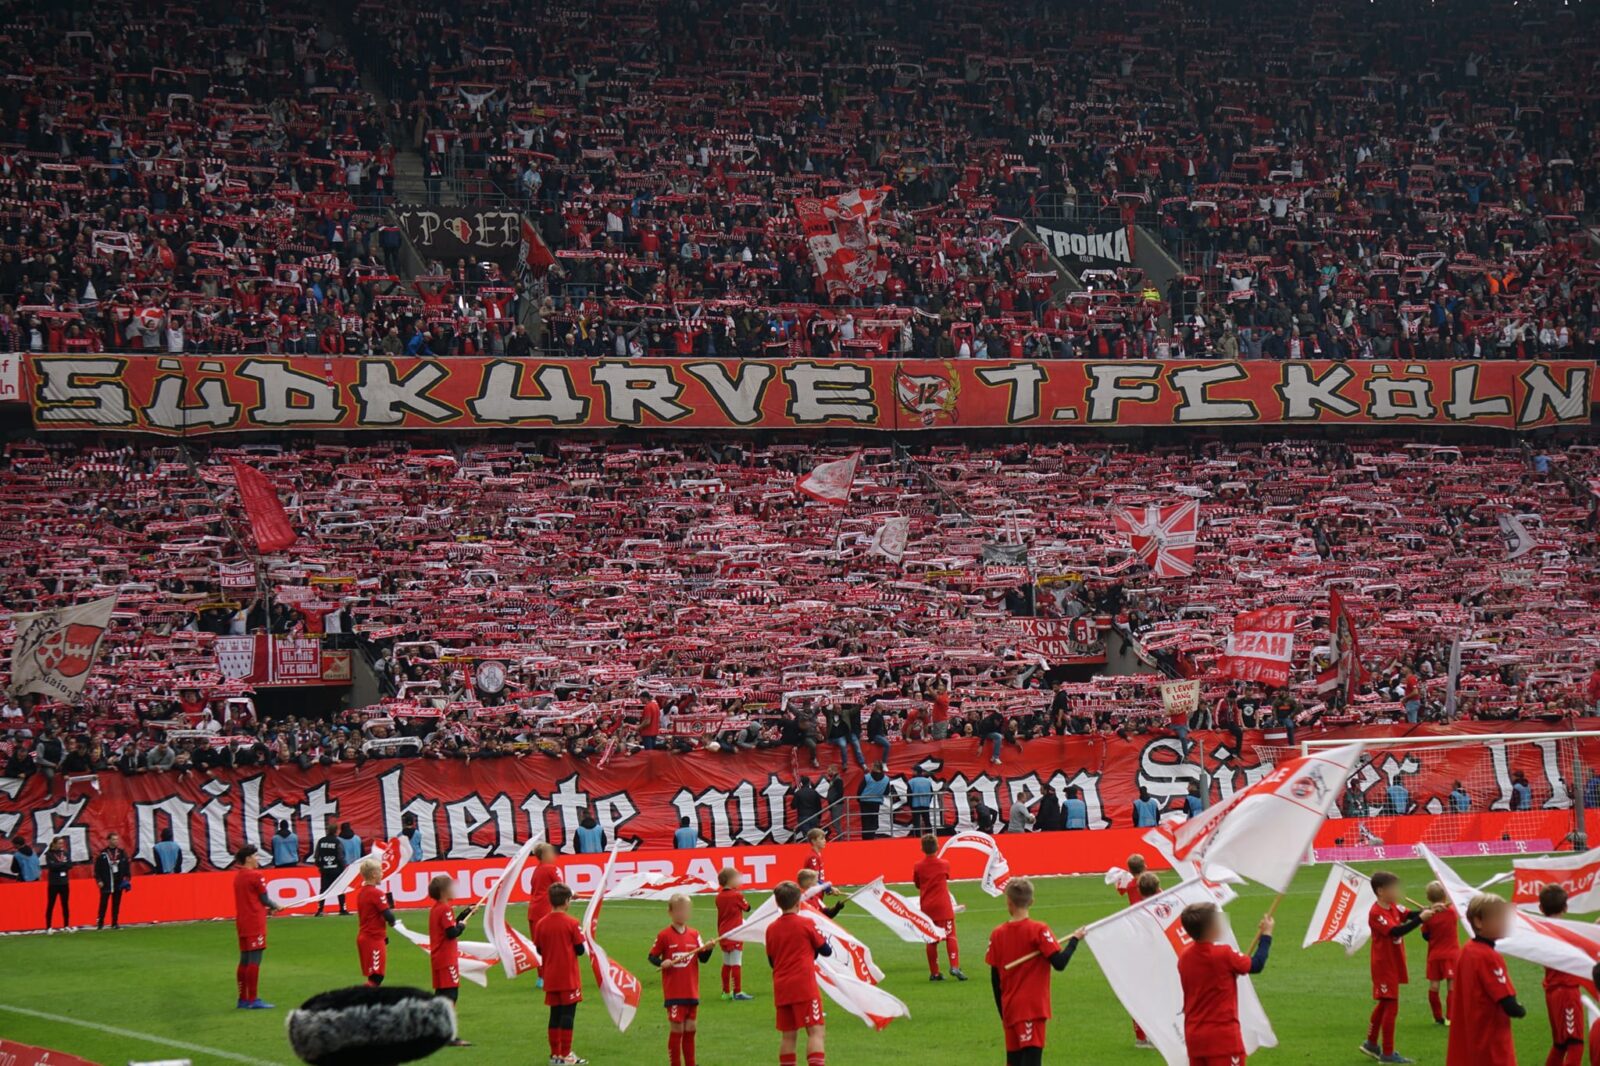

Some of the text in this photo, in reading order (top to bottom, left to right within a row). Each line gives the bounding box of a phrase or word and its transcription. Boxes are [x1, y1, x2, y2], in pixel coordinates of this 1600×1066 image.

[1036, 225, 1131, 264] TROIKA
[33, 357, 880, 428] SÜDKURVE
[1275, 361, 1591, 429] KÖLN
[378, 764, 641, 862] heute
[670, 773, 833, 849] nu
